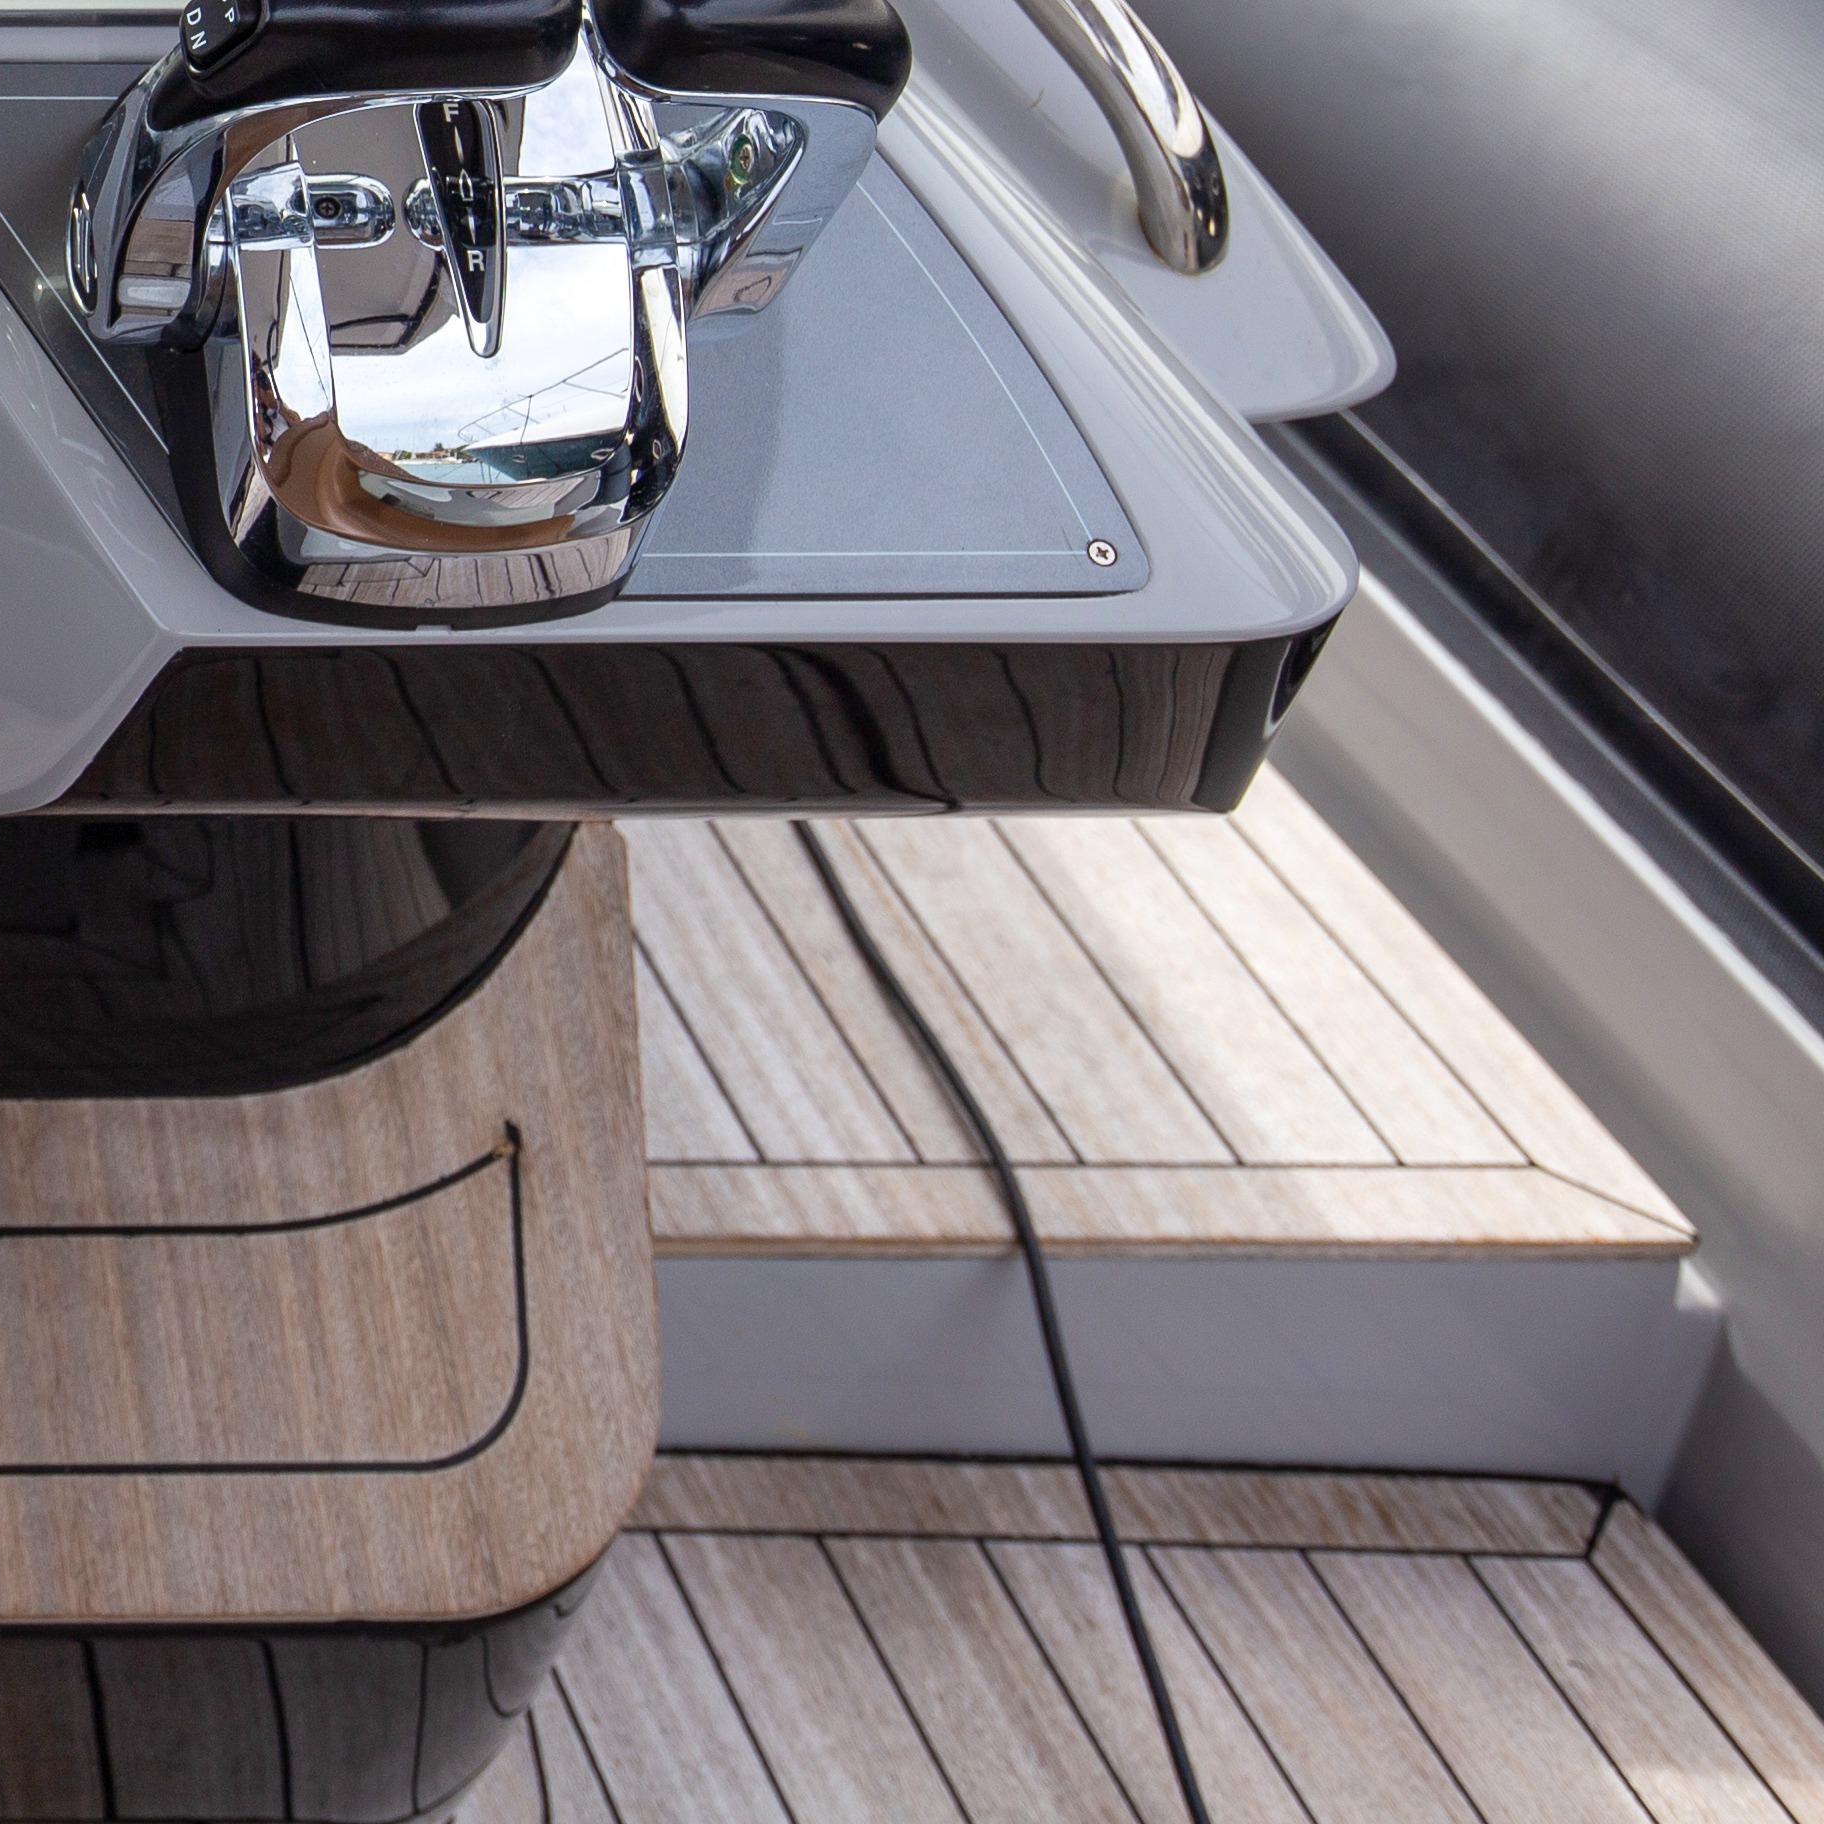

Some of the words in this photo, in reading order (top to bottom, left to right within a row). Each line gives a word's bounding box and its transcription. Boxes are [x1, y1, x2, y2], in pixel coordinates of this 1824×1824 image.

[186, 7, 207, 50] DN
[442, 103, 459, 122] F
[466, 250, 485, 272] R
